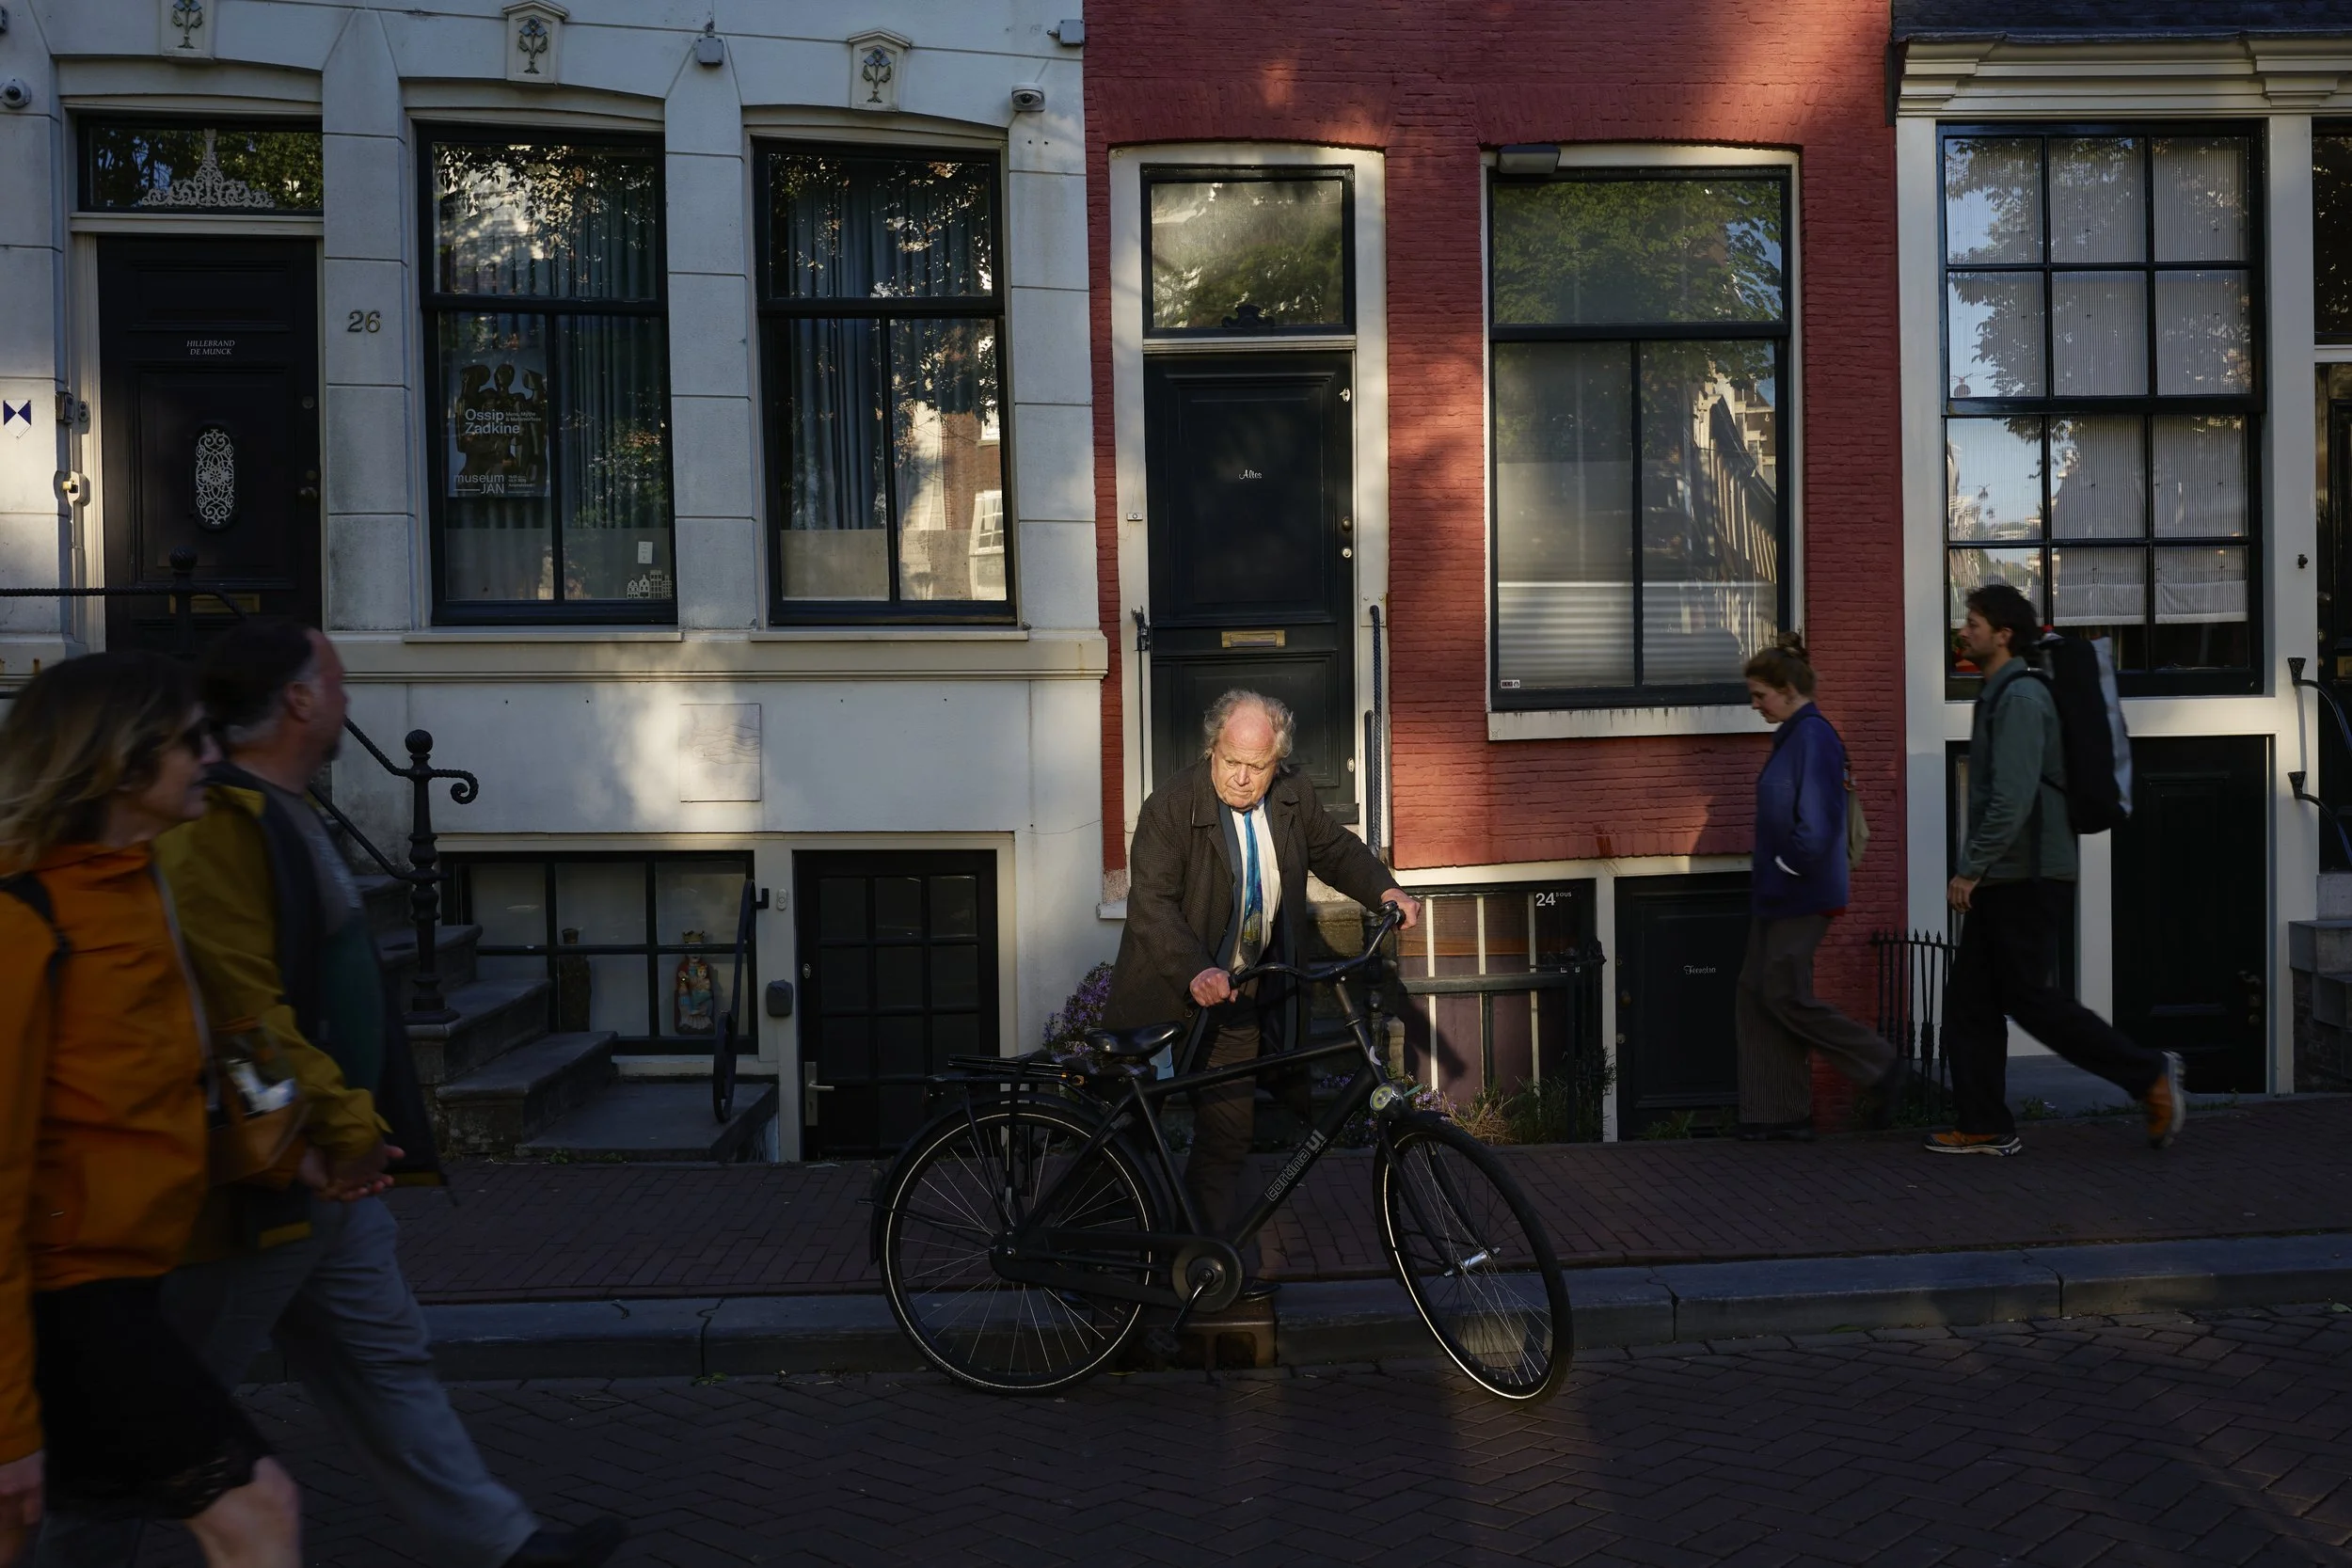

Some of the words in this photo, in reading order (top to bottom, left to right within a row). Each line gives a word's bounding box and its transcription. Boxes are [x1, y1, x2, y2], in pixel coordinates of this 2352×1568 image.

[347, 310, 381, 333] 26
[465, 408, 504, 422] Ossip
[465, 421, 520, 435] Zadkine
[453, 474, 505, 483] museum
[481, 483, 505, 494] JAN
[1535, 893, 1556, 907] 24
